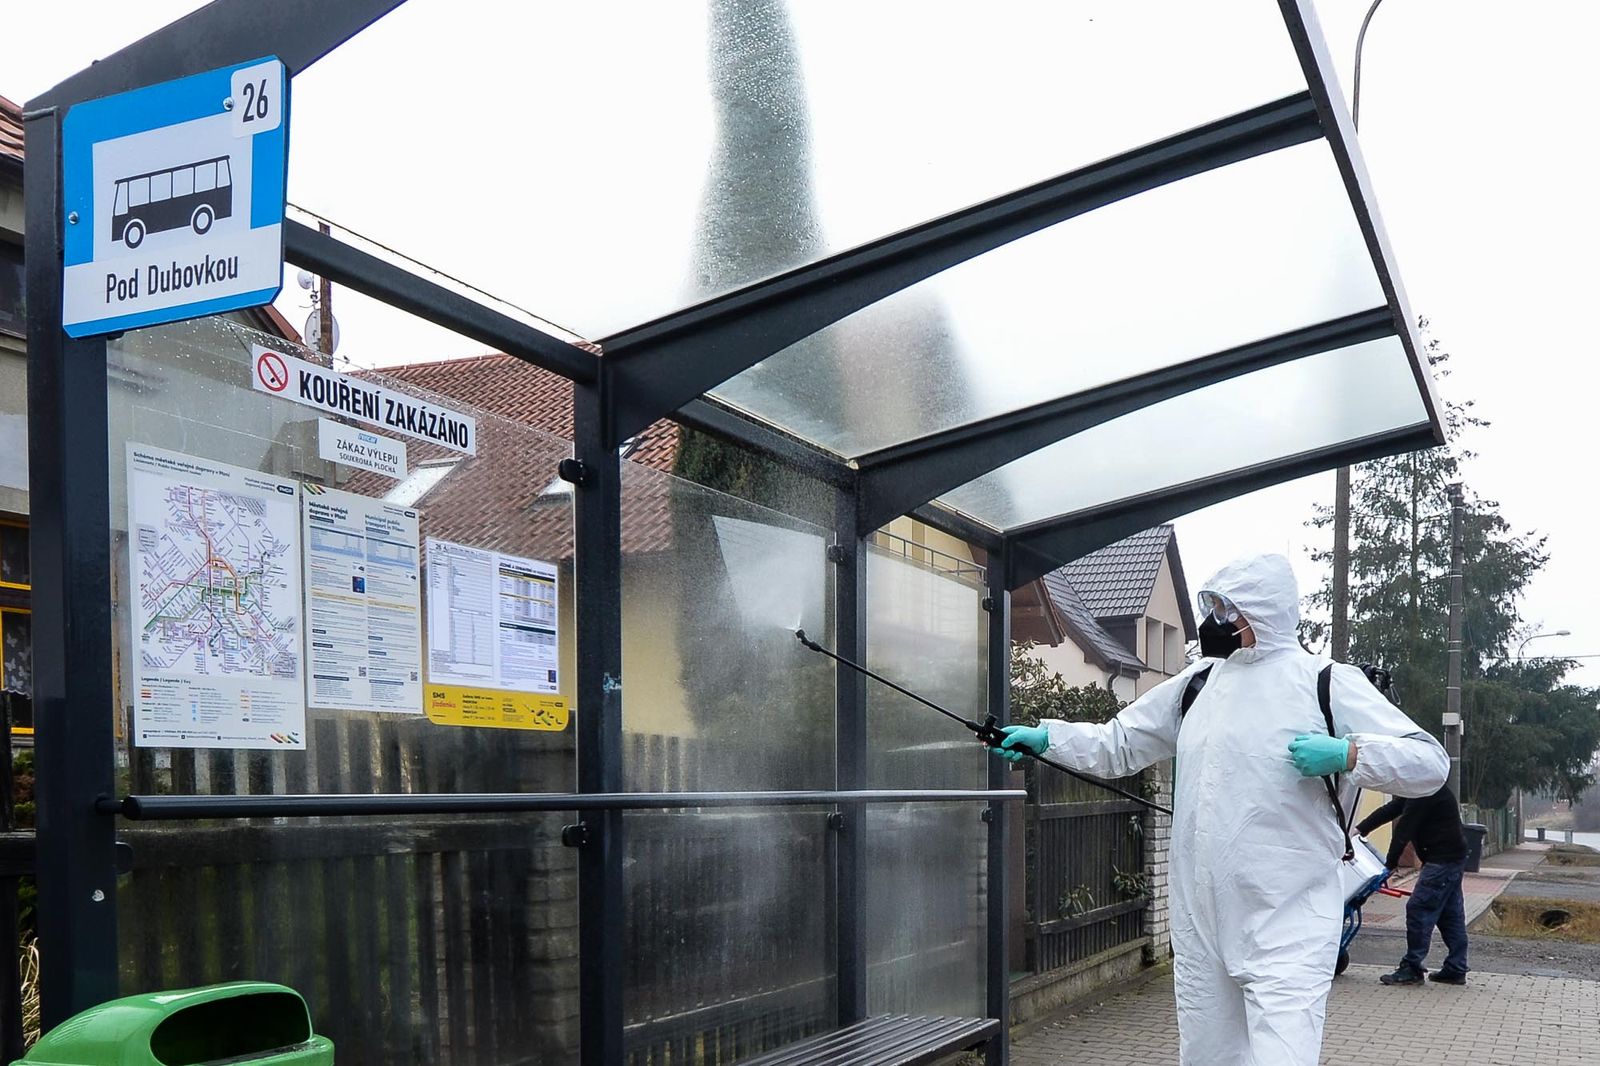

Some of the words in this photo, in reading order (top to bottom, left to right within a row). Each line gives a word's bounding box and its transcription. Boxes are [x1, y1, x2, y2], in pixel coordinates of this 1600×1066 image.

[242, 78, 269, 123] 26
[106, 268, 139, 303] Pod
[147, 254, 239, 296] Dubovkou
[299, 370, 381, 422] KOUŘENÍ
[385, 399, 469, 449] ZAKÁZÁNO
